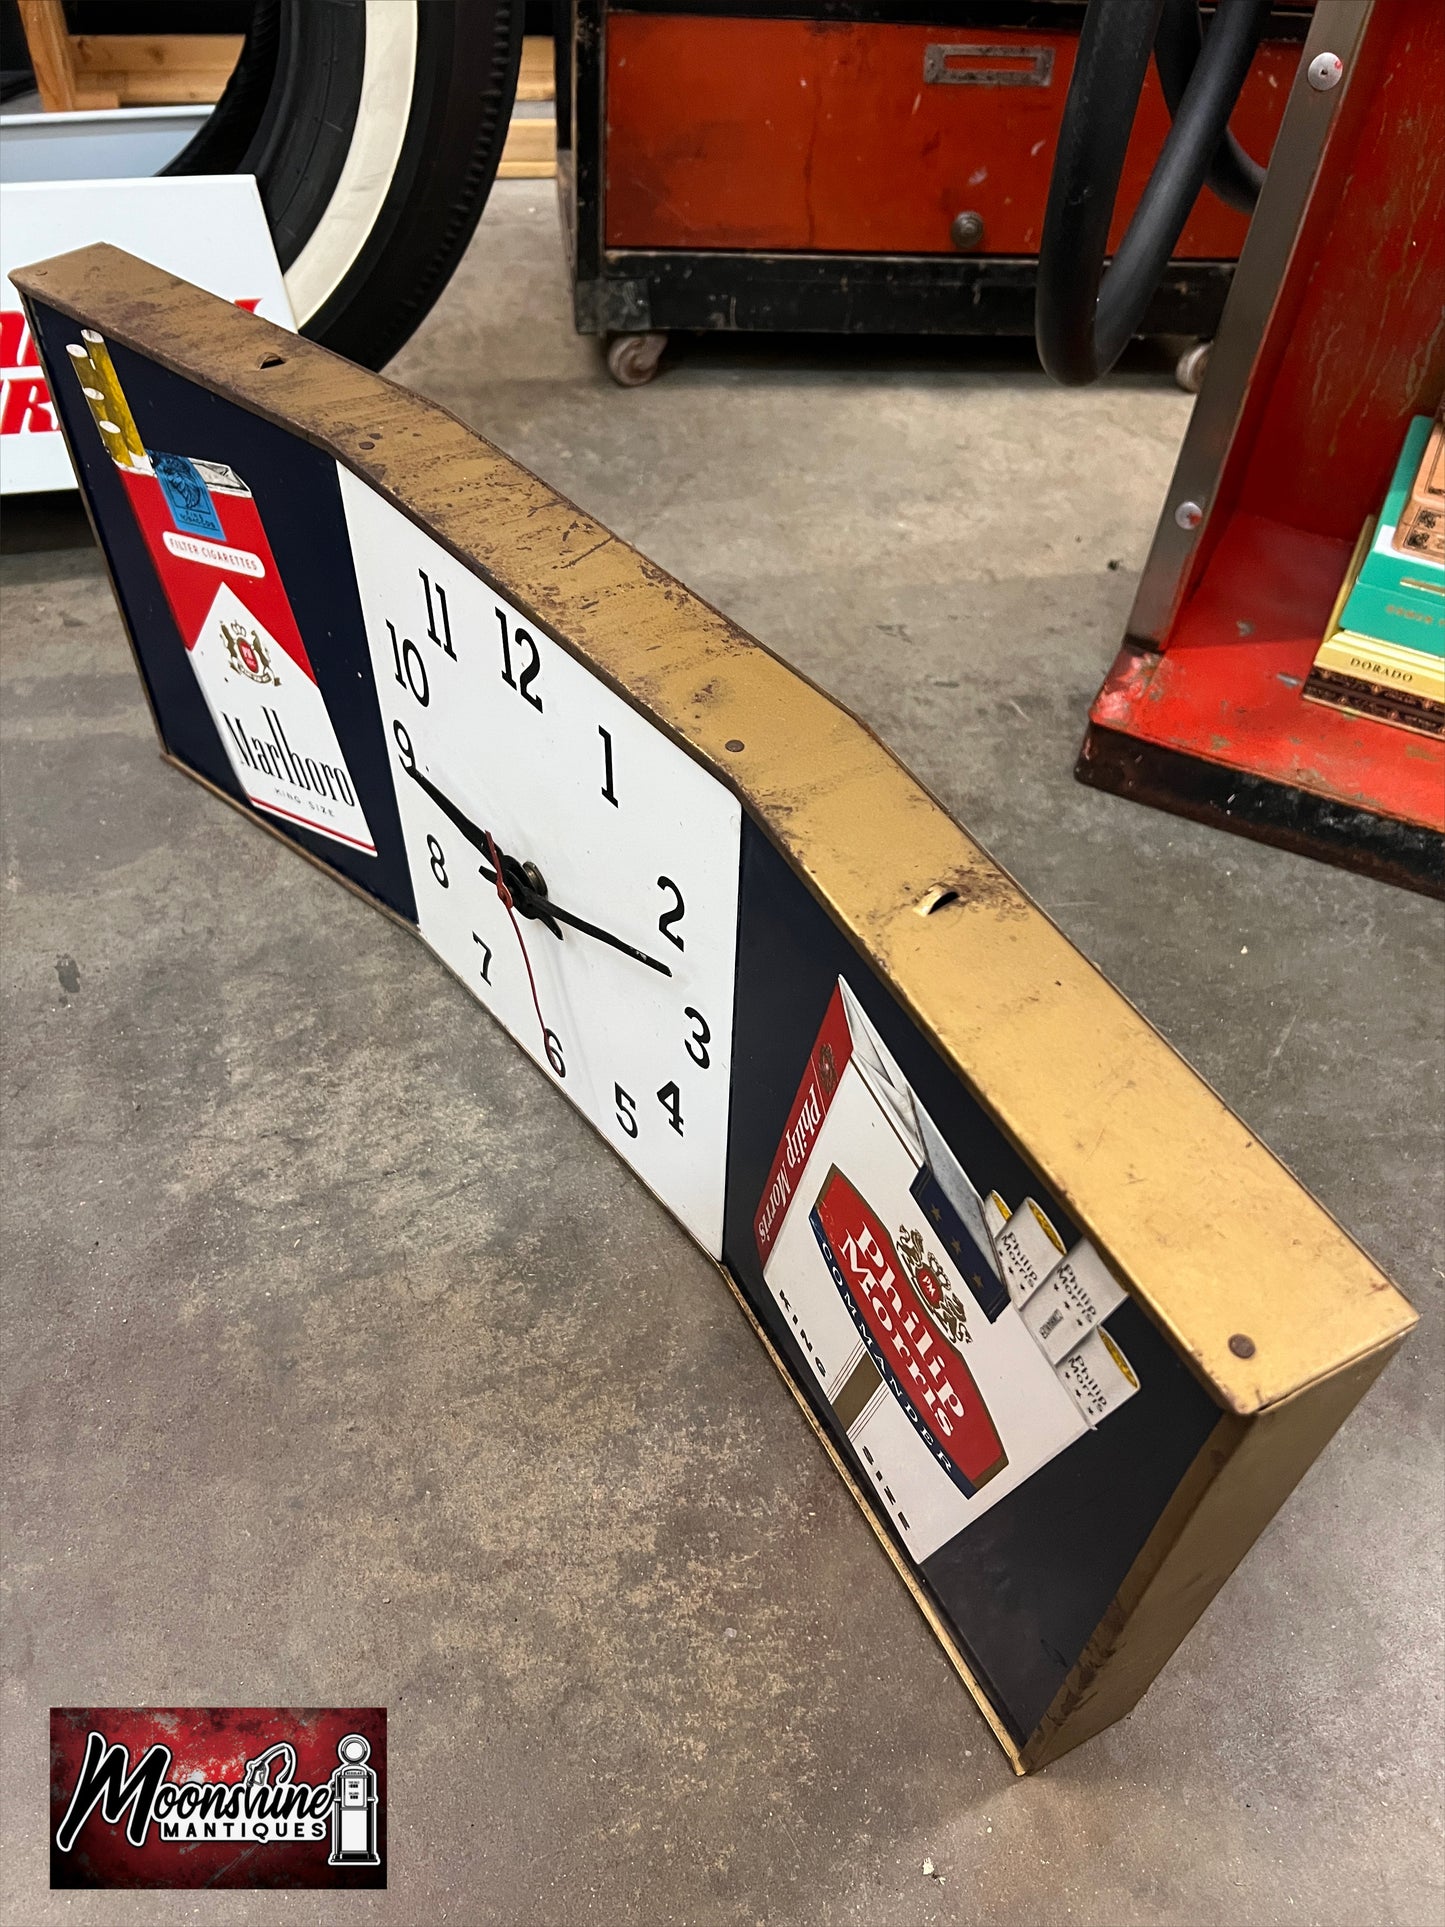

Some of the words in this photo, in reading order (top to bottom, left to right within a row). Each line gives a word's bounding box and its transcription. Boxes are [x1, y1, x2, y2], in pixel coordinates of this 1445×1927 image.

[169, 538, 198, 553] FILTER
[201, 547, 258, 571] CIGARETTES
[418, 568, 457, 662] 11
[386, 618, 430, 708] 10
[495, 606, 543, 714] 12
[1350, 657, 1413, 682] DORADO
[221, 705, 355, 807] Marlboro
[393, 719, 417, 778] 9
[599, 725, 619, 807] 1
[426, 834, 449, 888] 8
[657, 876, 685, 951] 2
[472, 931, 493, 986] 7
[544, 1028, 566, 1078] 6
[684, 1006, 711, 1069] 3
[615, 1081, 638, 1139] 5
[656, 1080, 684, 1137] 4
[785, 1082, 822, 1169] Philip
[758, 1160, 791, 1245] Morris
[1001, 1234, 1035, 1288] Morris
[1007, 1231, 1038, 1281] Philip
[1056, 1266, 1093, 1324] Morris
[1064, 1263, 1097, 1316] Philip
[838, 1228, 954, 1437] Morris
[854, 1221, 965, 1418] Philip
[822, 1242, 953, 1472] COMMANDER
[1068, 1357, 1104, 1413] Morris
[1075, 1354, 1108, 1406] Philip
[779, 1289, 827, 1378] KING
[862, 1445, 911, 1531] SIZE
